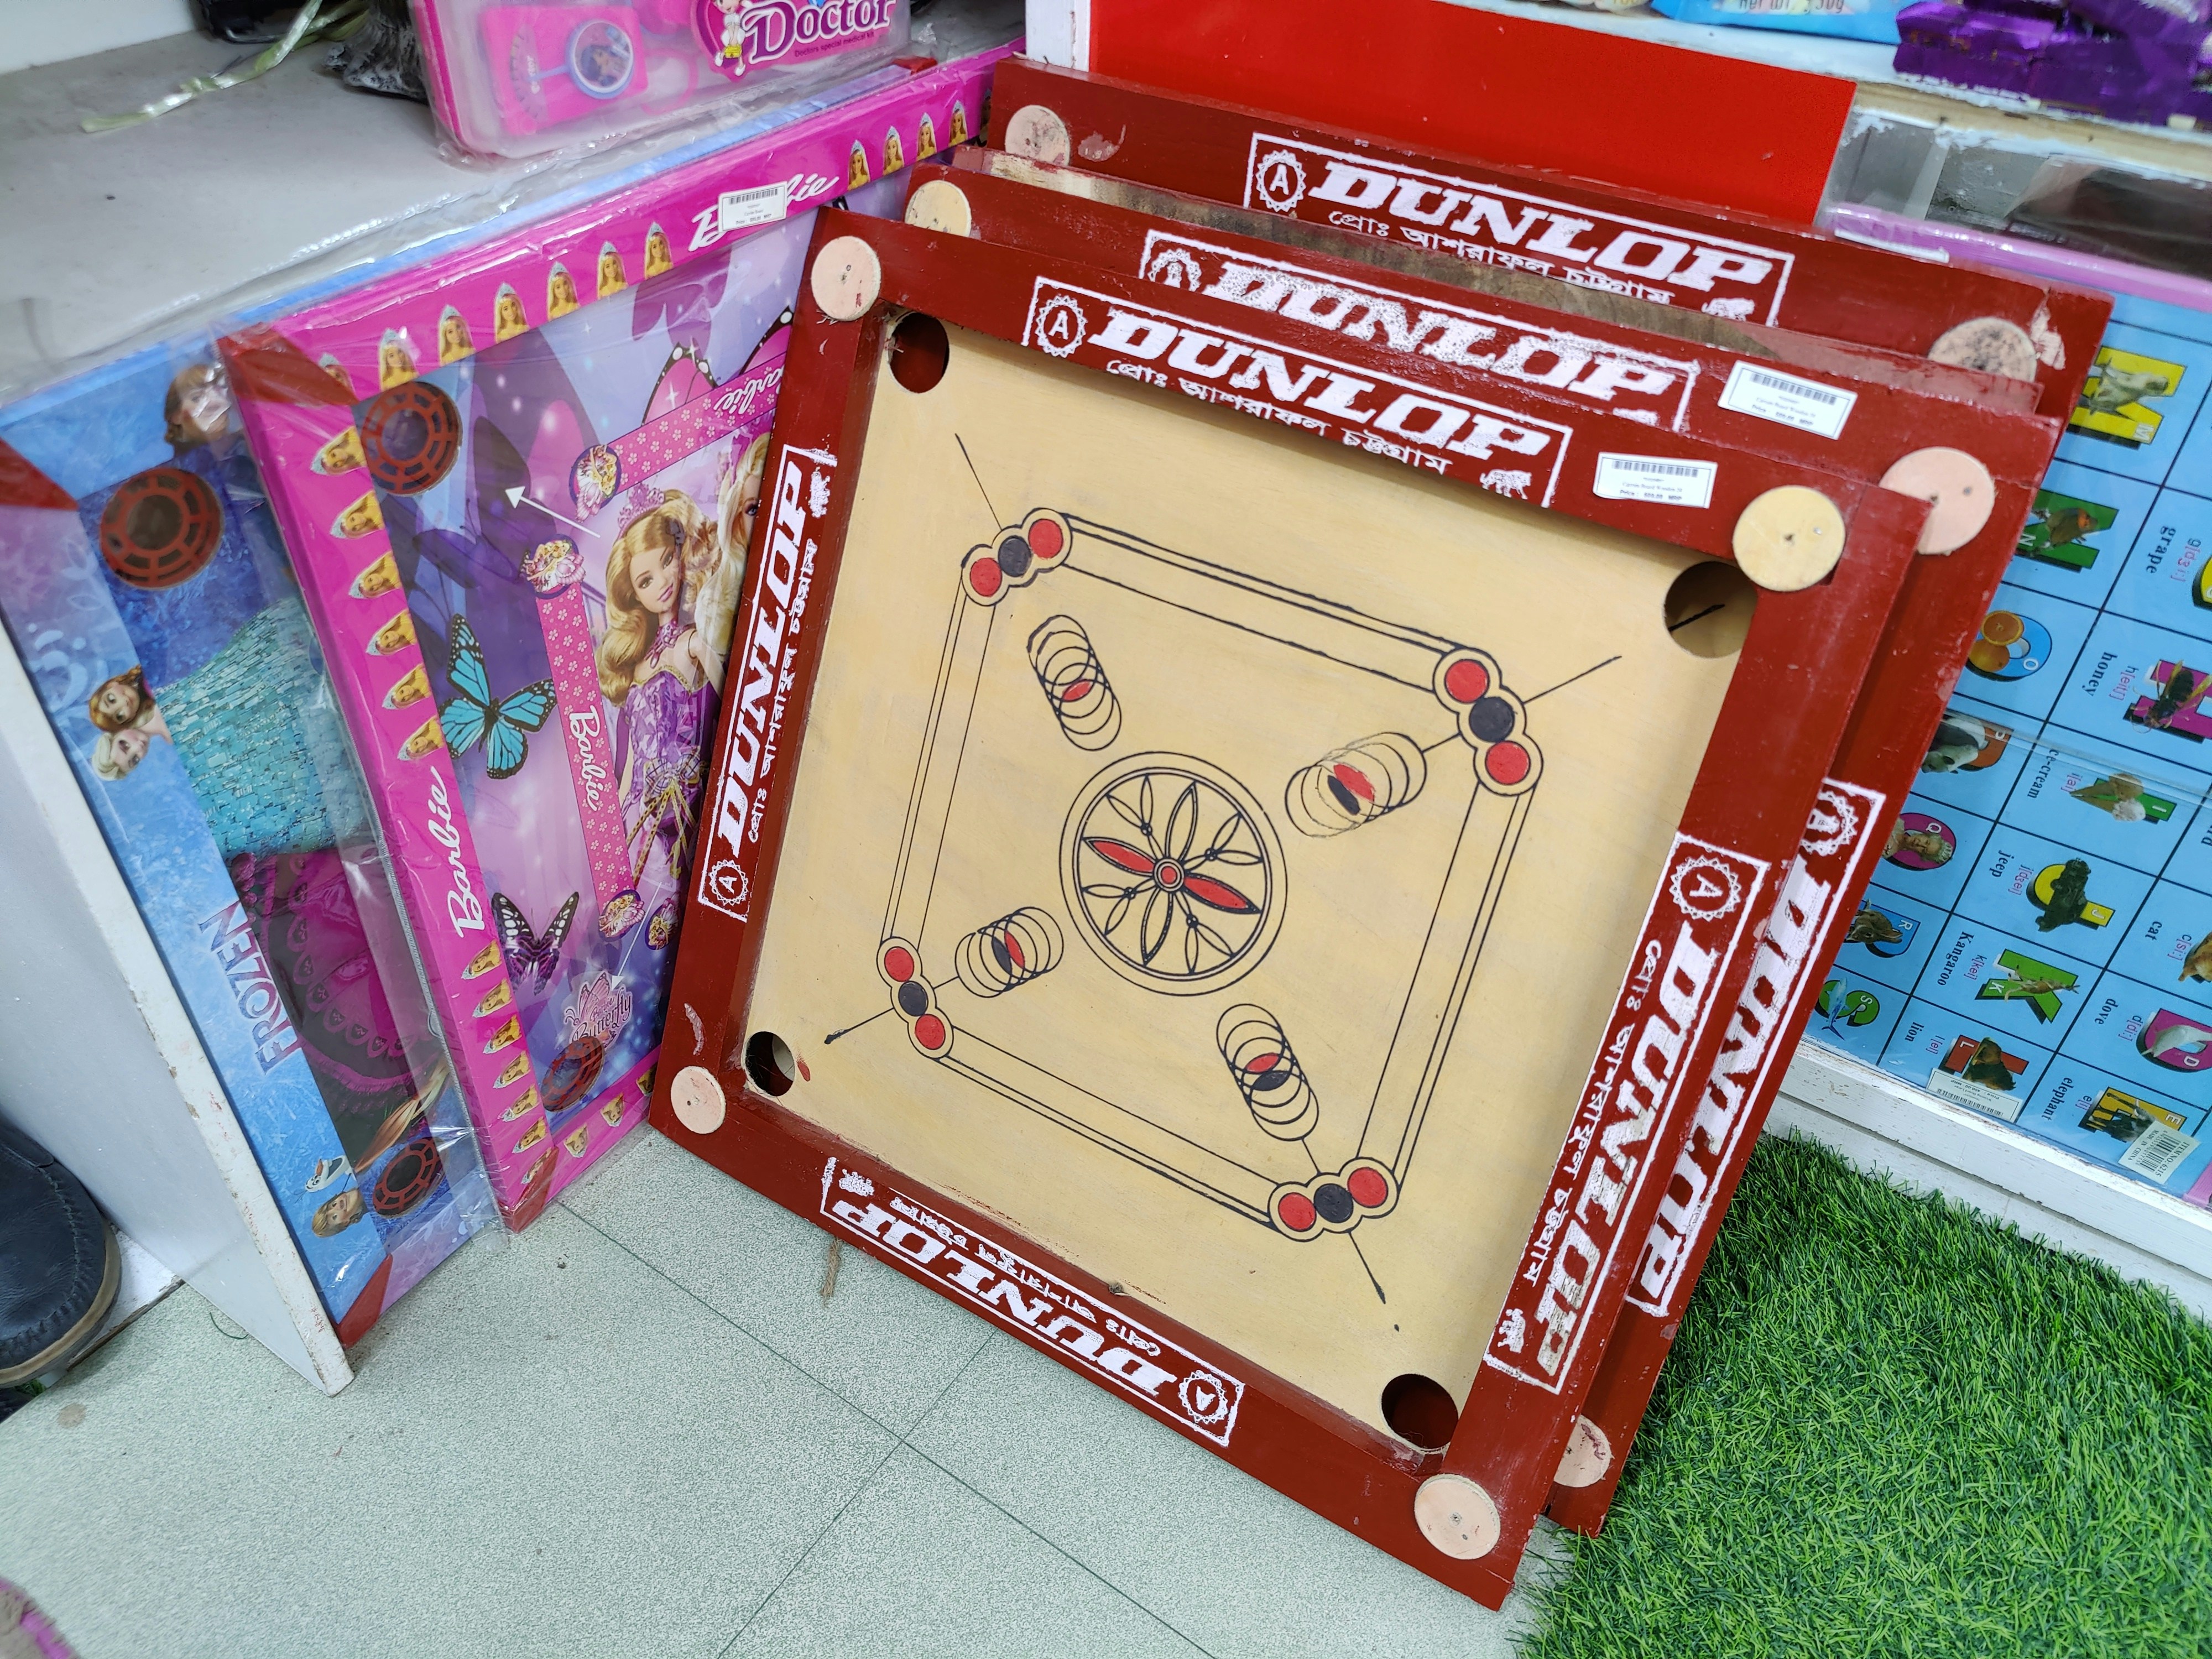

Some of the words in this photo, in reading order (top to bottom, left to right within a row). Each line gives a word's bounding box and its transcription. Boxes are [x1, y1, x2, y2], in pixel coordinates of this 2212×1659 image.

[740, 0, 896, 64] Doctor
[795, 46, 819, 58] Doctors
[821, 39, 842, 51] special
[843, 34, 867, 46] medical
[1270, 164, 1288, 196] A
[1308, 160, 1773, 292] DUNLOP
[1050, 310, 1070, 340] A
[1202, 260, 1676, 404] DUNLOP
[714, 363, 785, 415] arbie
[1088, 305, 1551, 460] DUNLOP
[2146, 526, 2177, 574] grape
[718, 461, 804, 858] DUNLOP
[2082, 651, 2118, 696] honey
[568, 705, 607, 812] Barbie
[2027, 749, 2059, 799] ce-cream
[1926, 822, 1942, 834] Q
[431, 766, 485, 938] Barbie
[1989, 850, 2015, 878] jeep
[715, 875, 737, 895] A
[1688, 873, 1724, 901] A
[1898, 920, 1913, 931] R
[2145, 921, 2162, 941] cat
[1937, 931, 1974, 986] Kangaroo
[197, 899, 303, 1076] FROZEN
[1860, 995, 1874, 1004] S
[1989, 982, 2005, 994] K
[572, 986, 632, 1042] Butterfly
[2095, 998, 2119, 1025] dove
[1905, 1022, 1925, 1042] lion
[2184, 1055, 2200, 1067] D
[2041, 1077, 2074, 1121] elephant
[2165, 1113, 2182, 1125] E
[1536, 919, 1721, 1377] DUNLOP
[2147, 1130, 2159, 1140] MADE
[2128, 1147, 2142, 1161] CHINA
[2156, 1164, 2168, 1177] 6215
[832, 1199, 1177, 1396] DUNLOP
[1196, 1384, 1217, 1411] A
